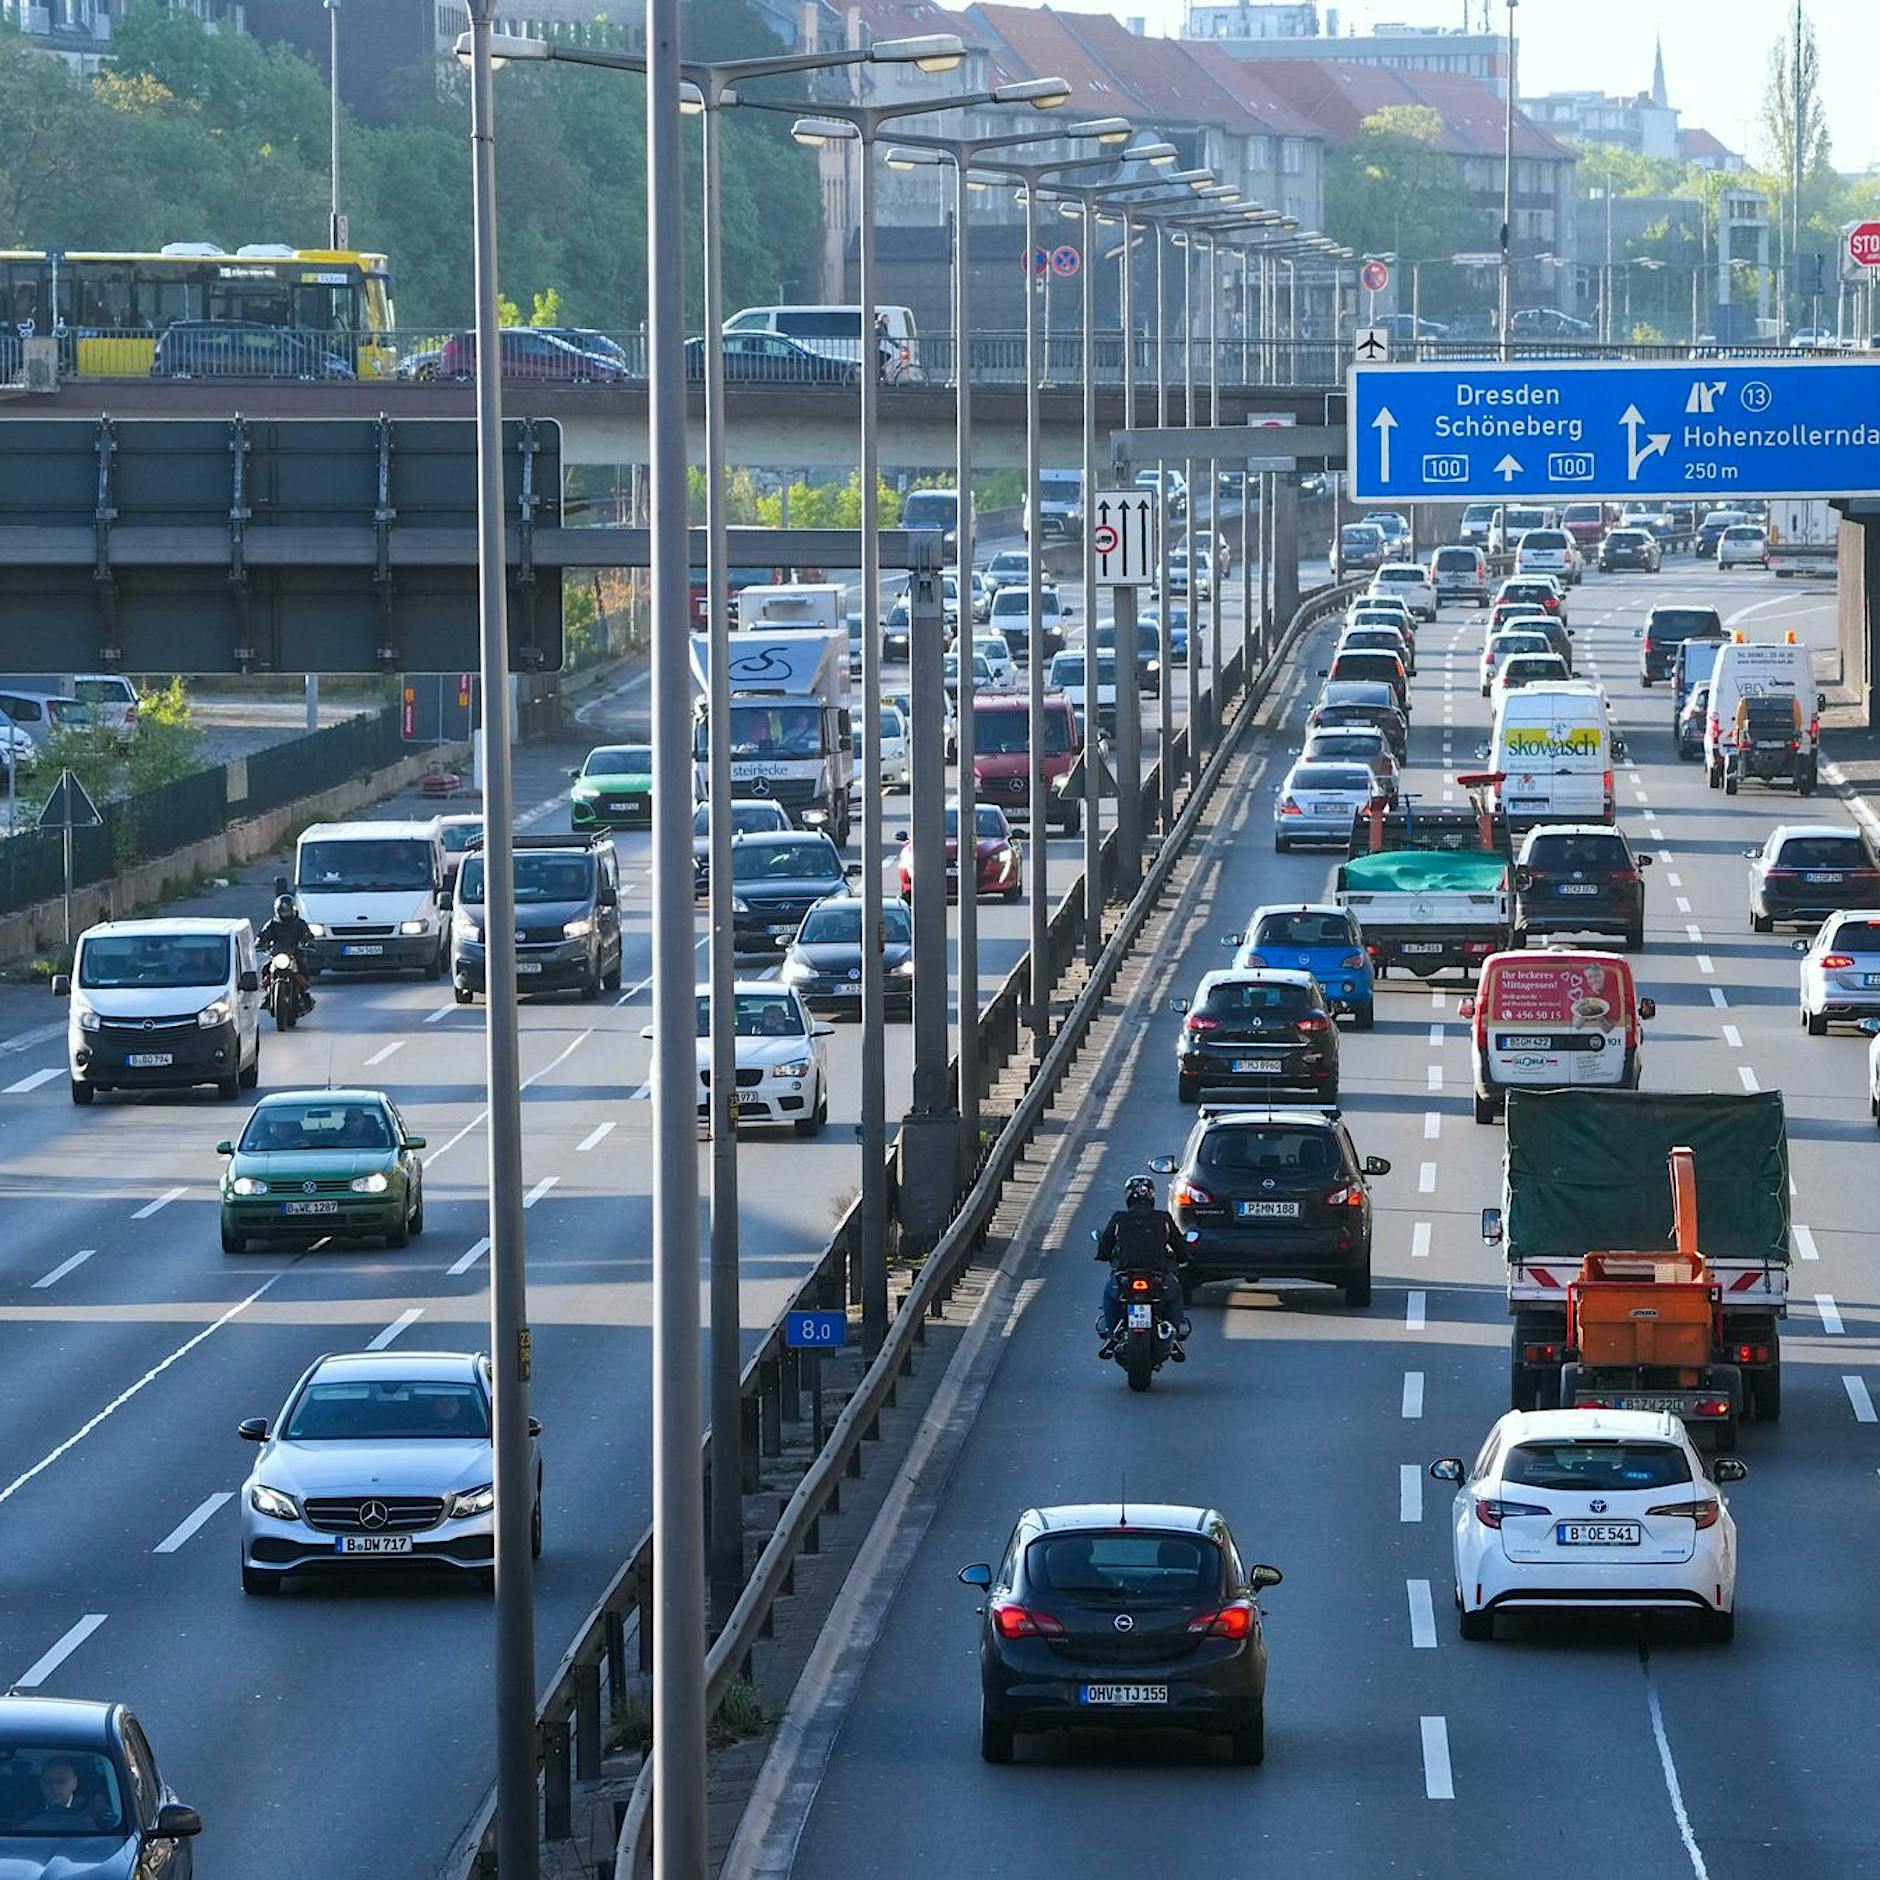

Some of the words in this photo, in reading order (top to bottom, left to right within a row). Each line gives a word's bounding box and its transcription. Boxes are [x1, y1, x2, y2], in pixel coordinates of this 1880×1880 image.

[1852, 235, 1880, 253] STO
[1457, 384, 1560, 406] Dresden
[1747, 388, 1766, 405] 13
[1435, 415, 1583, 441] Schöneberg
[1683, 424, 1880, 447] Hohenzollernda
[1430, 459, 1461, 477] 100
[1556, 458, 1586, 476] 100
[1684, 462, 1717, 480] 250
[1721, 466, 1738, 479] m
[1508, 733, 1598, 758] skowasch
[1502, 971, 1516, 979] Ihr
[1518, 971, 1554, 980] leckeres
[1502, 981, 1558, 990] Mittagessen!
[1516, 1010, 1533, 1020] 456
[1536, 1010, 1548, 1020] 50
[1550, 1010, 1562, 1020] 15
[313, 1202, 337, 1212] 1287
[1248, 1204, 1255, 1213] P
[1276, 1204, 1295, 1214] 188
[802, 1319, 830, 1340] 8.0
[1571, 1527, 1579, 1540] B
[1588, 1527, 1605, 1540] OE
[1608, 1527, 1633, 1540] 541
[347, 1538, 355, 1551] B
[364, 1538, 380, 1551] DW
[383, 1538, 407, 1551] 717
[1089, 1687, 1114, 1701] OHV
[1123, 1687, 1140, 1701] TJ
[1142, 1687, 1167, 1701] 155
